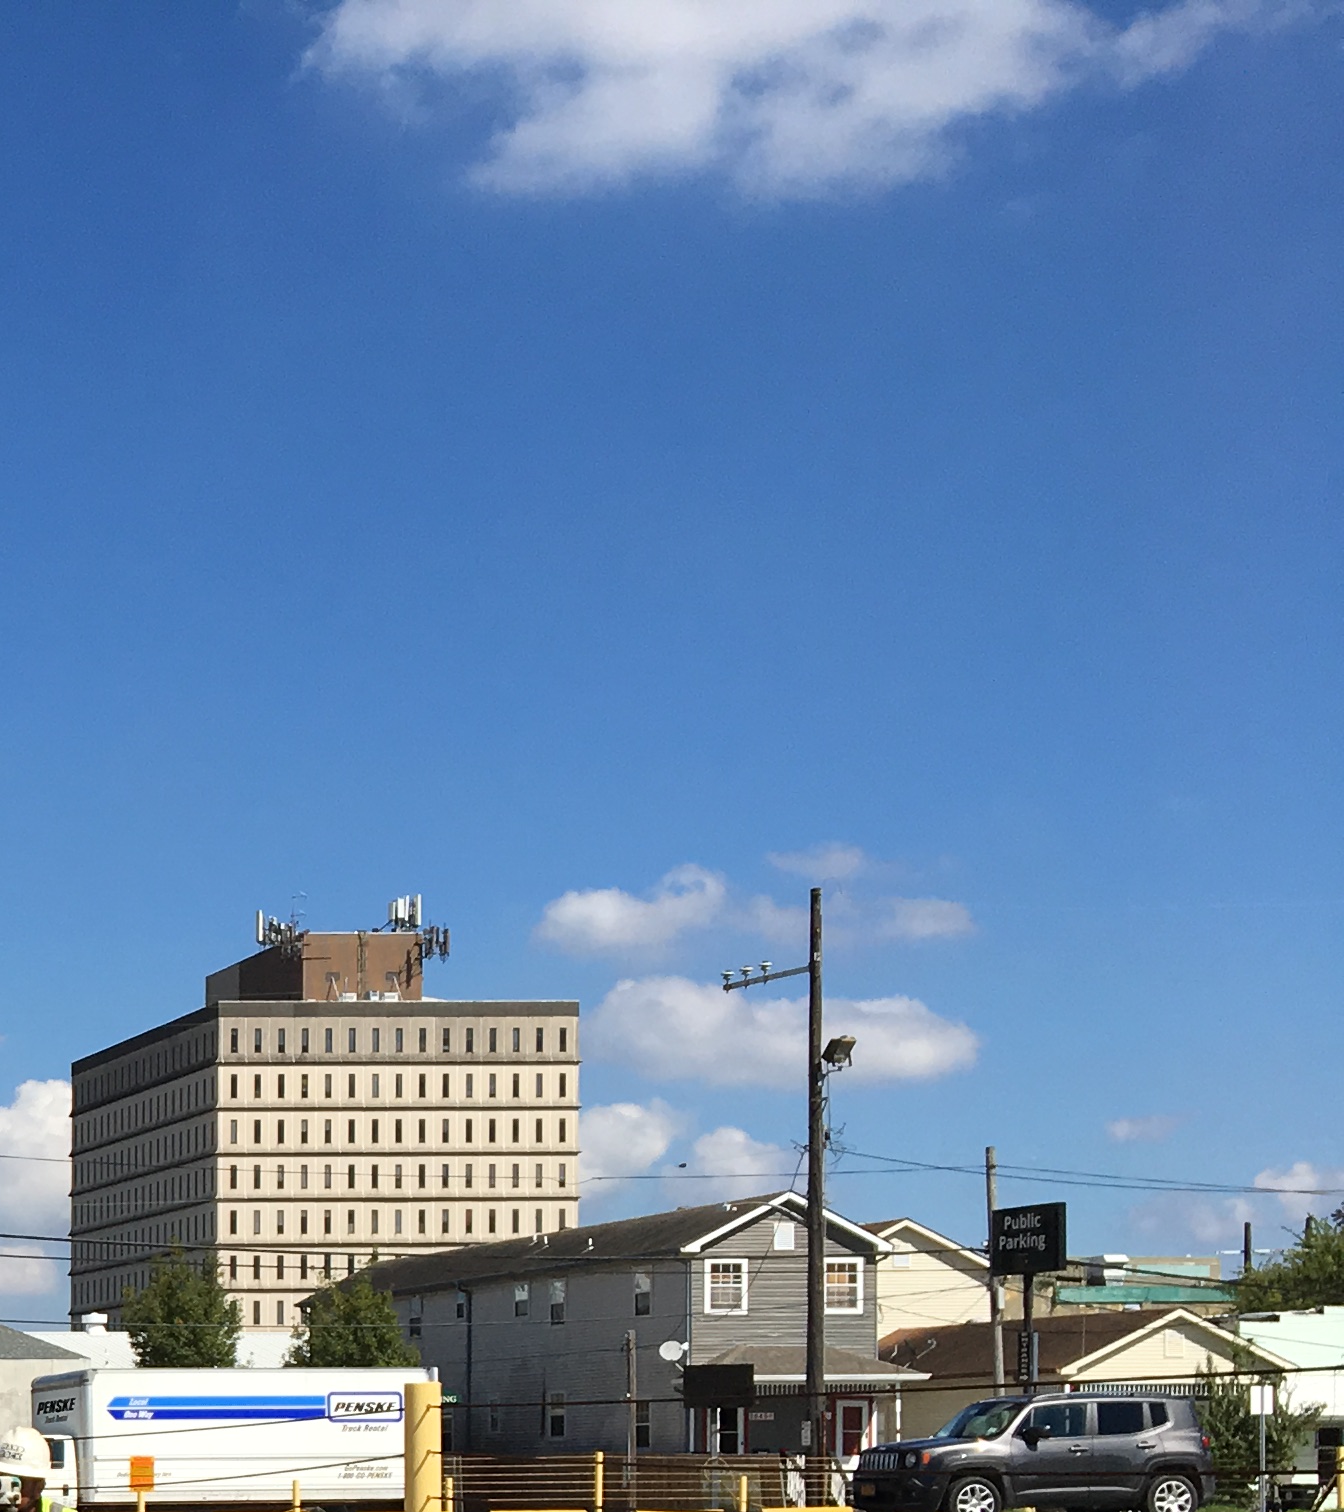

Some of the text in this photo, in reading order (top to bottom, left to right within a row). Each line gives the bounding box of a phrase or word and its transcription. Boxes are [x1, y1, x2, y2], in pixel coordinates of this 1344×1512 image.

[1004, 1212, 1042, 1231] Public
[998, 1231, 1047, 1251] Parking
[37, 1397, 77, 1416] PENSKE
[128, 1398, 150, 1407] Local
[334, 1401, 397, 1413] PENSKE
[341, 1424, 389, 1432] Truck Rental
